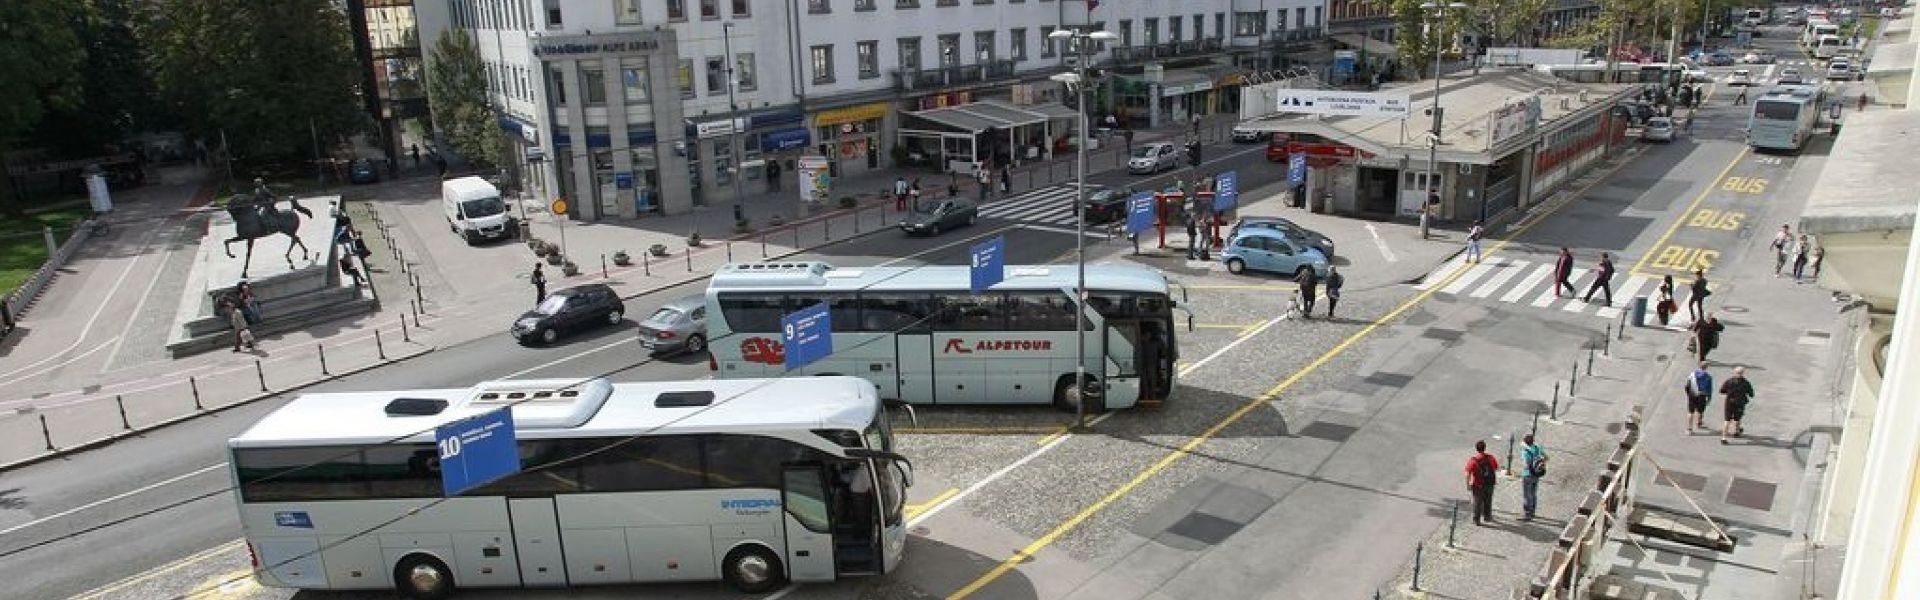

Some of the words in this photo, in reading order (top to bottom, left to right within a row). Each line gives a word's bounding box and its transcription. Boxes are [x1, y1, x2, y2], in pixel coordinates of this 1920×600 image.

[1721, 176, 1769, 194] BUS
[1686, 208, 1746, 231] BUS
[1651, 245, 1721, 273] BUS
[786, 323, 794, 340] 9
[976, 340, 1051, 351] ALPETOUR
[439, 436, 461, 460] 10
